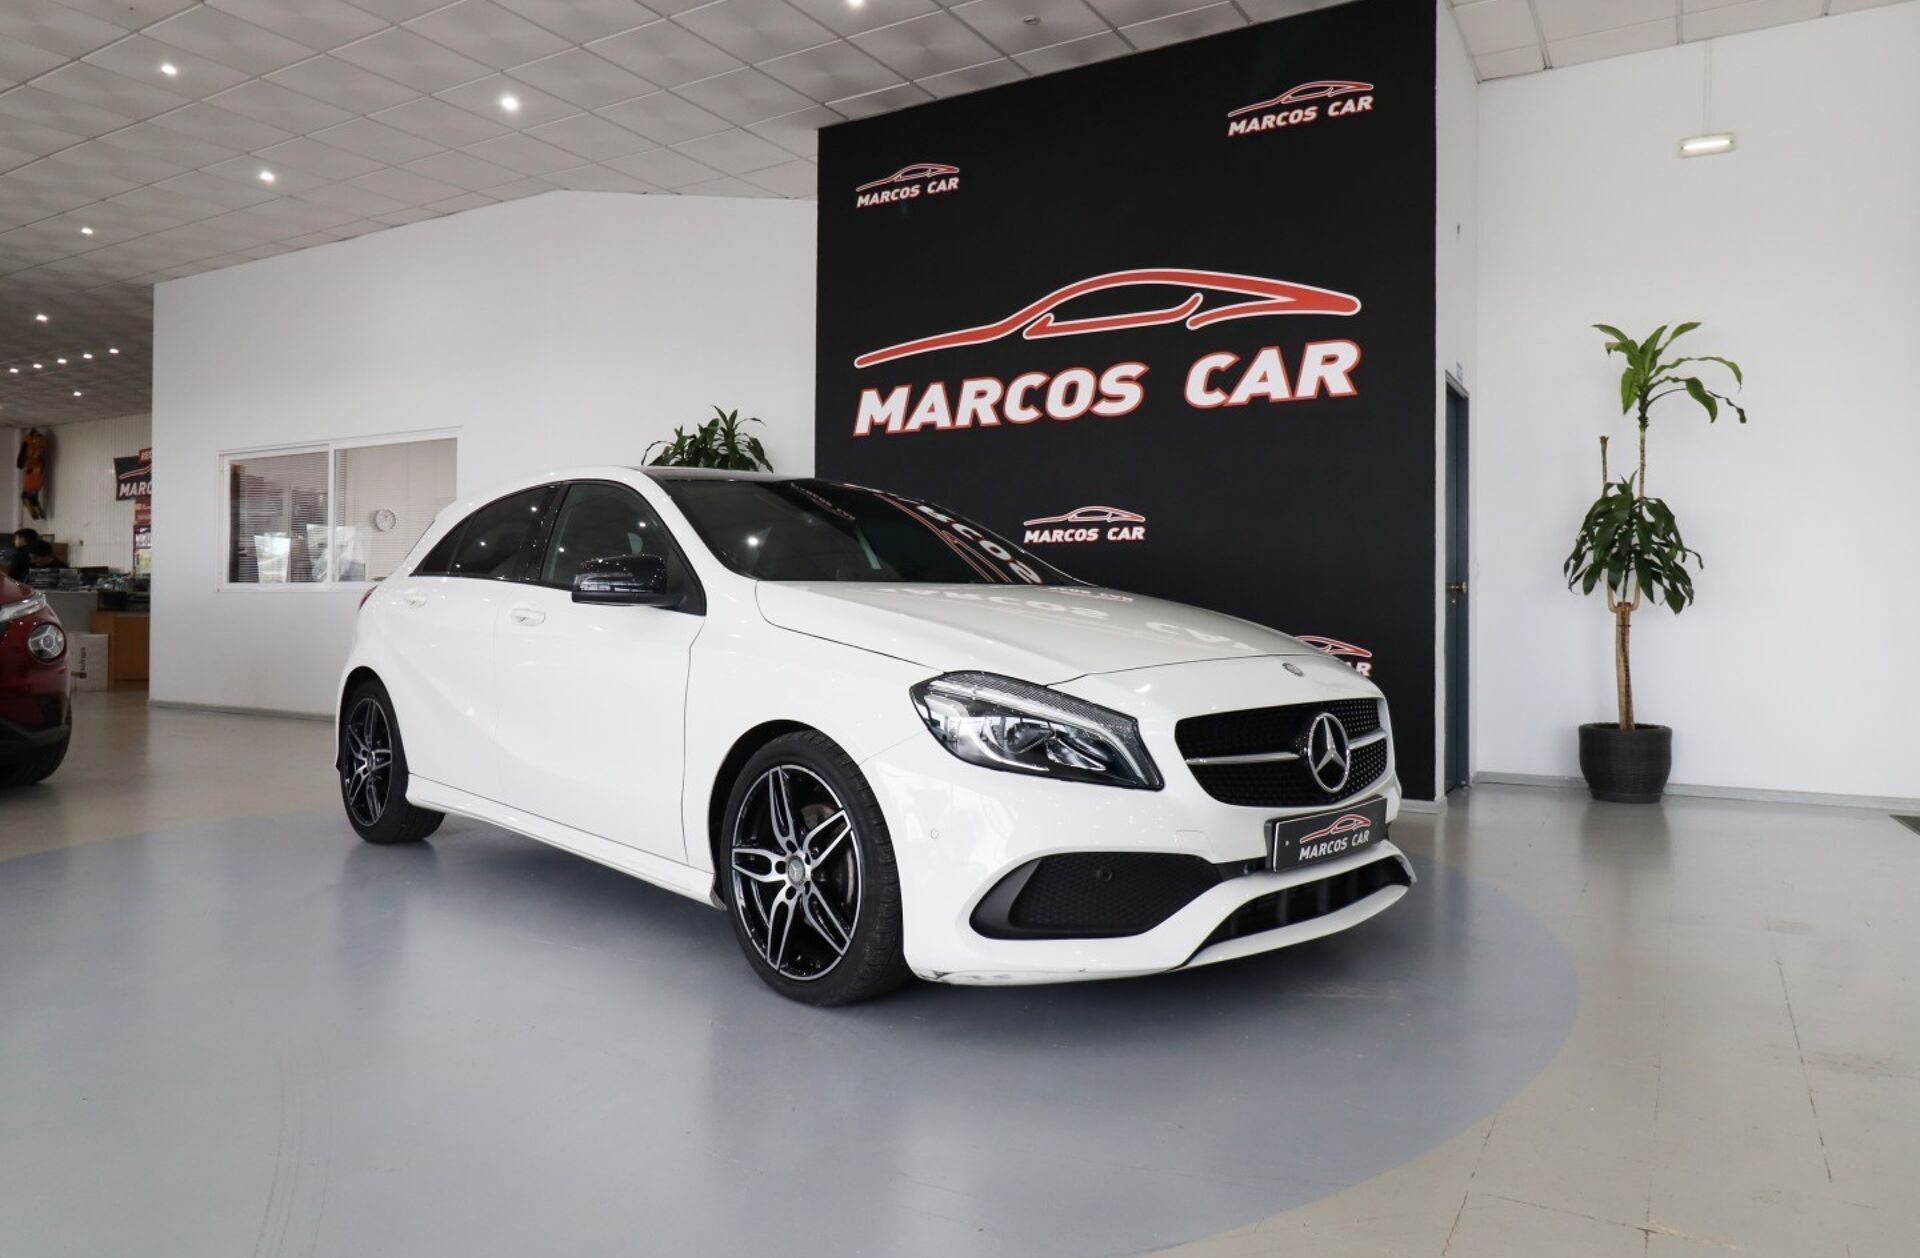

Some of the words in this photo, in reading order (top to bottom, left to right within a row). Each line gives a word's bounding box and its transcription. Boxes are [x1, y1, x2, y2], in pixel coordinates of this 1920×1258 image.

[1228, 106, 1319, 136] MARCOS
[1327, 95, 1374, 117] CAR
[856, 184, 921, 208] MARCOS
[927, 177, 959, 194] CAR
[854, 361, 1150, 437] MARCOS
[1185, 339, 1361, 409] CAR
[1023, 528, 1100, 543] MARCOS
[1107, 526, 1146, 541] CAR
[1299, 837, 1349, 861] MARCOS
[1351, 830, 1370, 847] CAR
